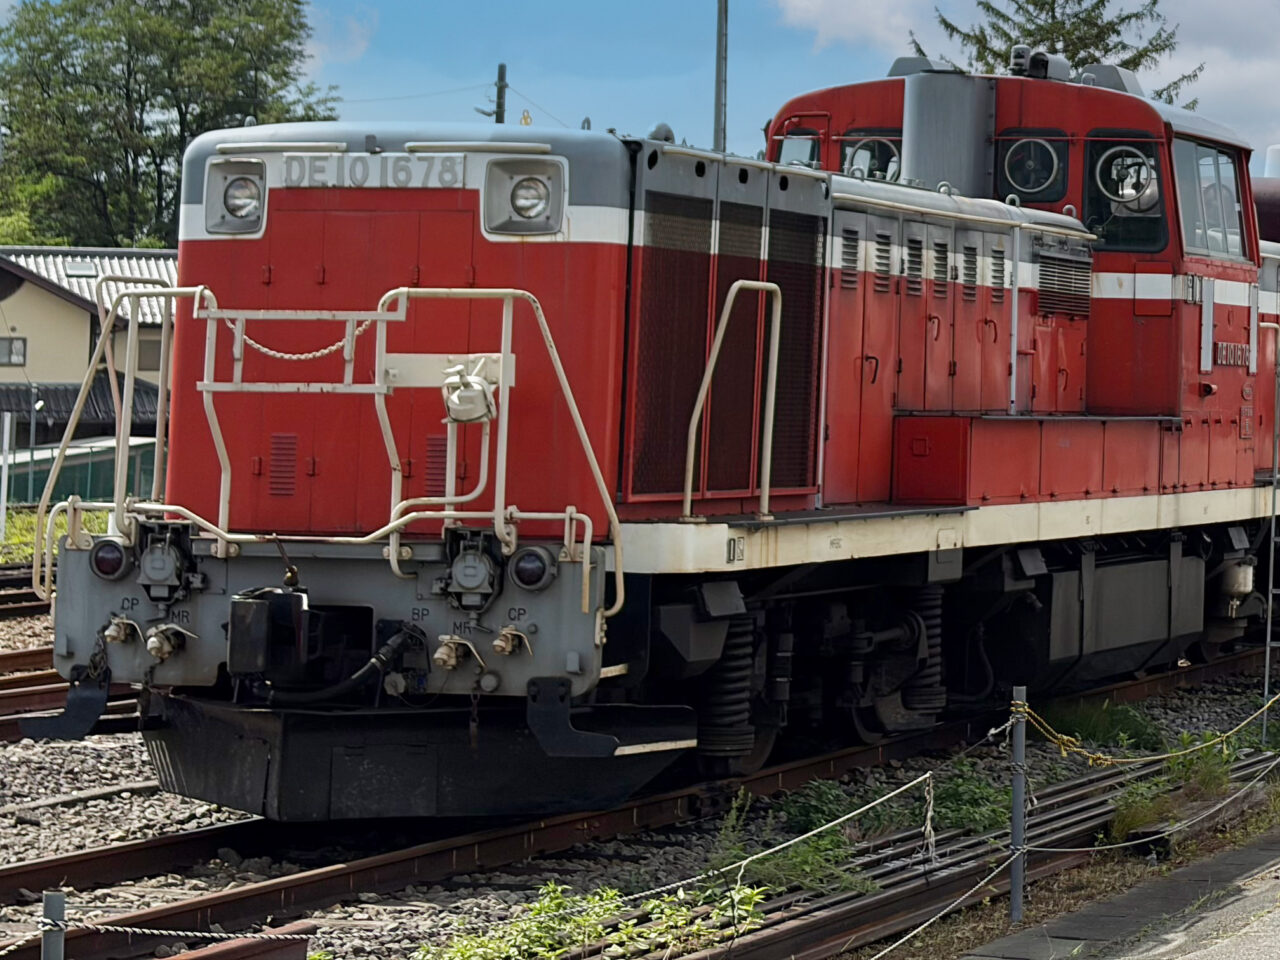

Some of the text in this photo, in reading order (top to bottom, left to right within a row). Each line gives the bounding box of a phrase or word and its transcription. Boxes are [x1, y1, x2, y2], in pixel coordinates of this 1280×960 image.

[121, 597, 139, 610] CP
[171, 609, 190, 623] MR
[411, 608, 430, 621] BP
[508, 607, 526, 620] CP
